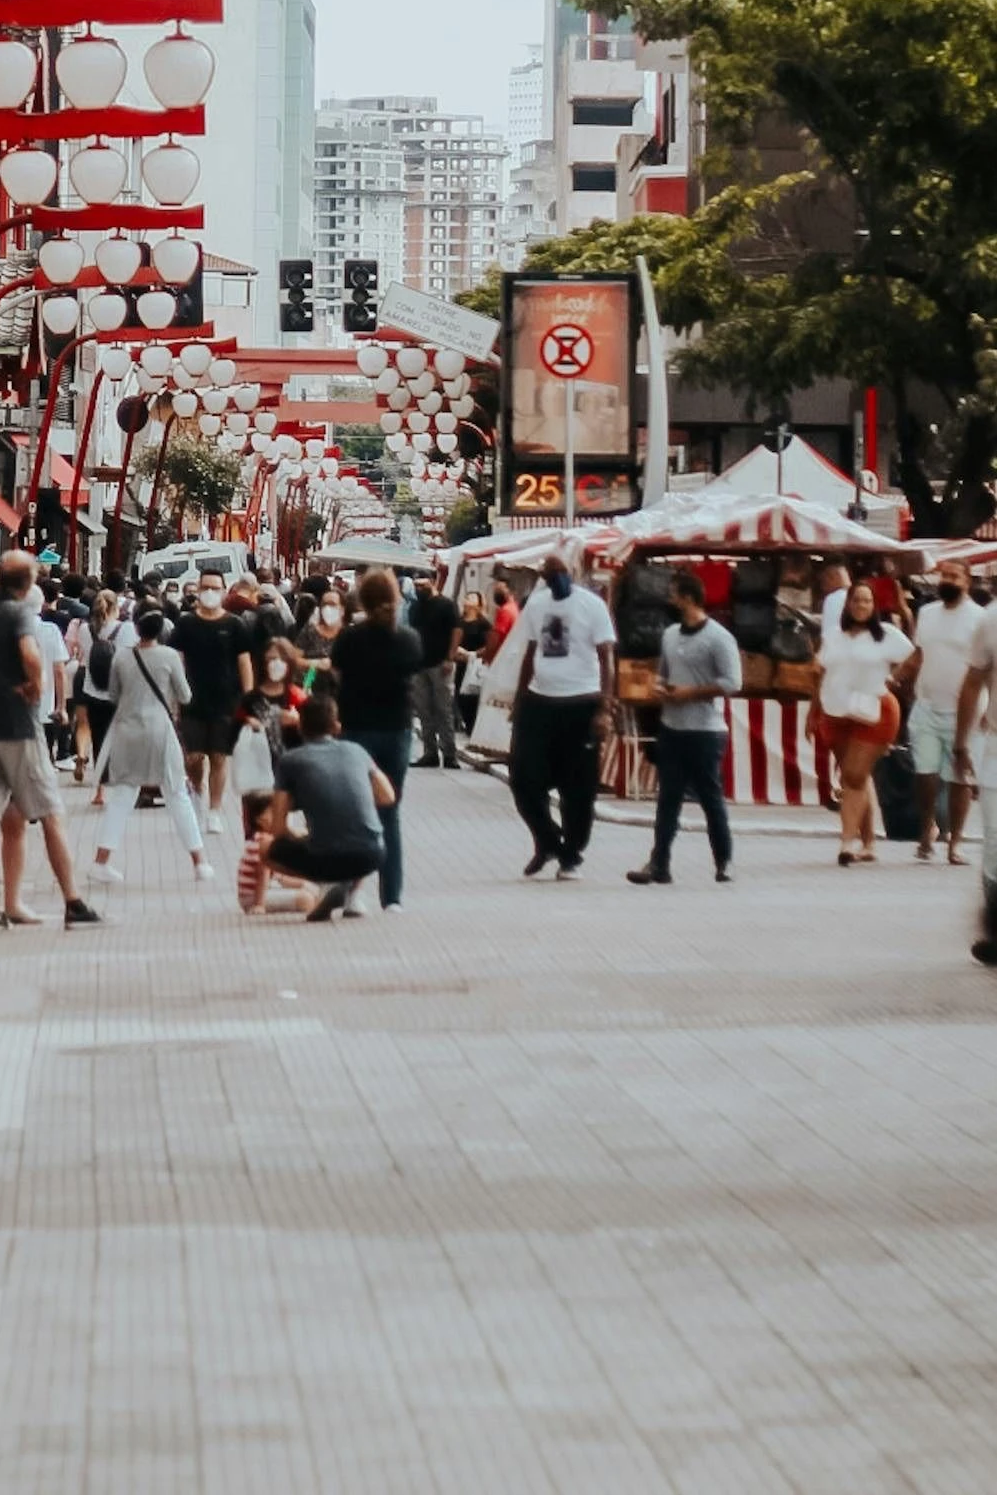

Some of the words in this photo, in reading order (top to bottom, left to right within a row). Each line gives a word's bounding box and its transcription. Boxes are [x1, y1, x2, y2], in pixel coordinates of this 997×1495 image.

[396, 301, 415, 314] COM
[385, 311, 430, 332] AMARELO
[515, 473, 560, 507] 25
